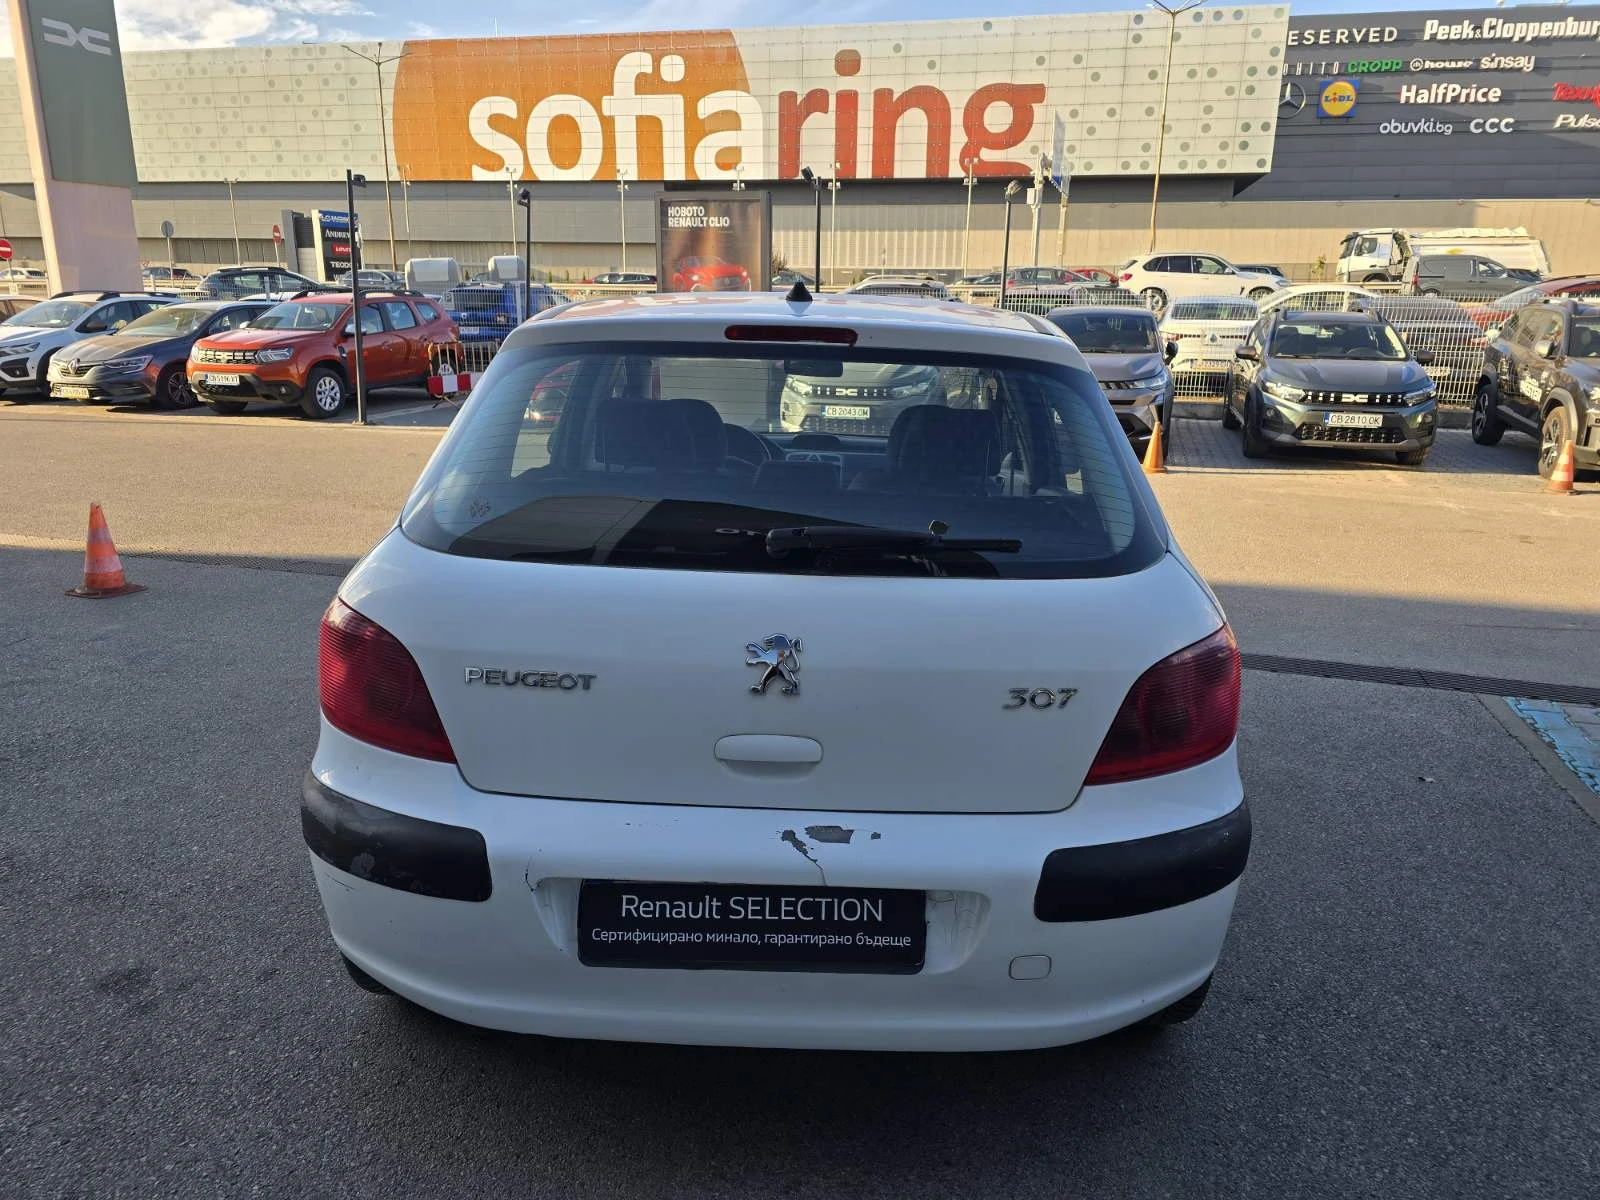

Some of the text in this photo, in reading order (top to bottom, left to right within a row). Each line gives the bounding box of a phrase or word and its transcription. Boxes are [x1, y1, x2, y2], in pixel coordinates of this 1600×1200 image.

[1287, 26, 1398, 46] ESERVED
[1423, 16, 1600, 43] Peek&Cloppenbur
[1347, 59, 1403, 73] CROPP
[1480, 53, 1536, 73] sinsay
[1400, 83, 1502, 104] HalfPrice
[1379, 118, 1453, 136] obuvki.bg
[1470, 118, 1515, 134] CCC
[668, 216, 730, 228] RENAULT CLIO
[1344, 415, 1367, 424] 2810
[464, 666, 597, 691] PEUGEOT
[1001, 687, 1079, 710] 307
[621, 894, 883, 922] Renault SELECTION
[592, 928, 912, 948] Сертифицирано минало, гарантирано бъдеще
